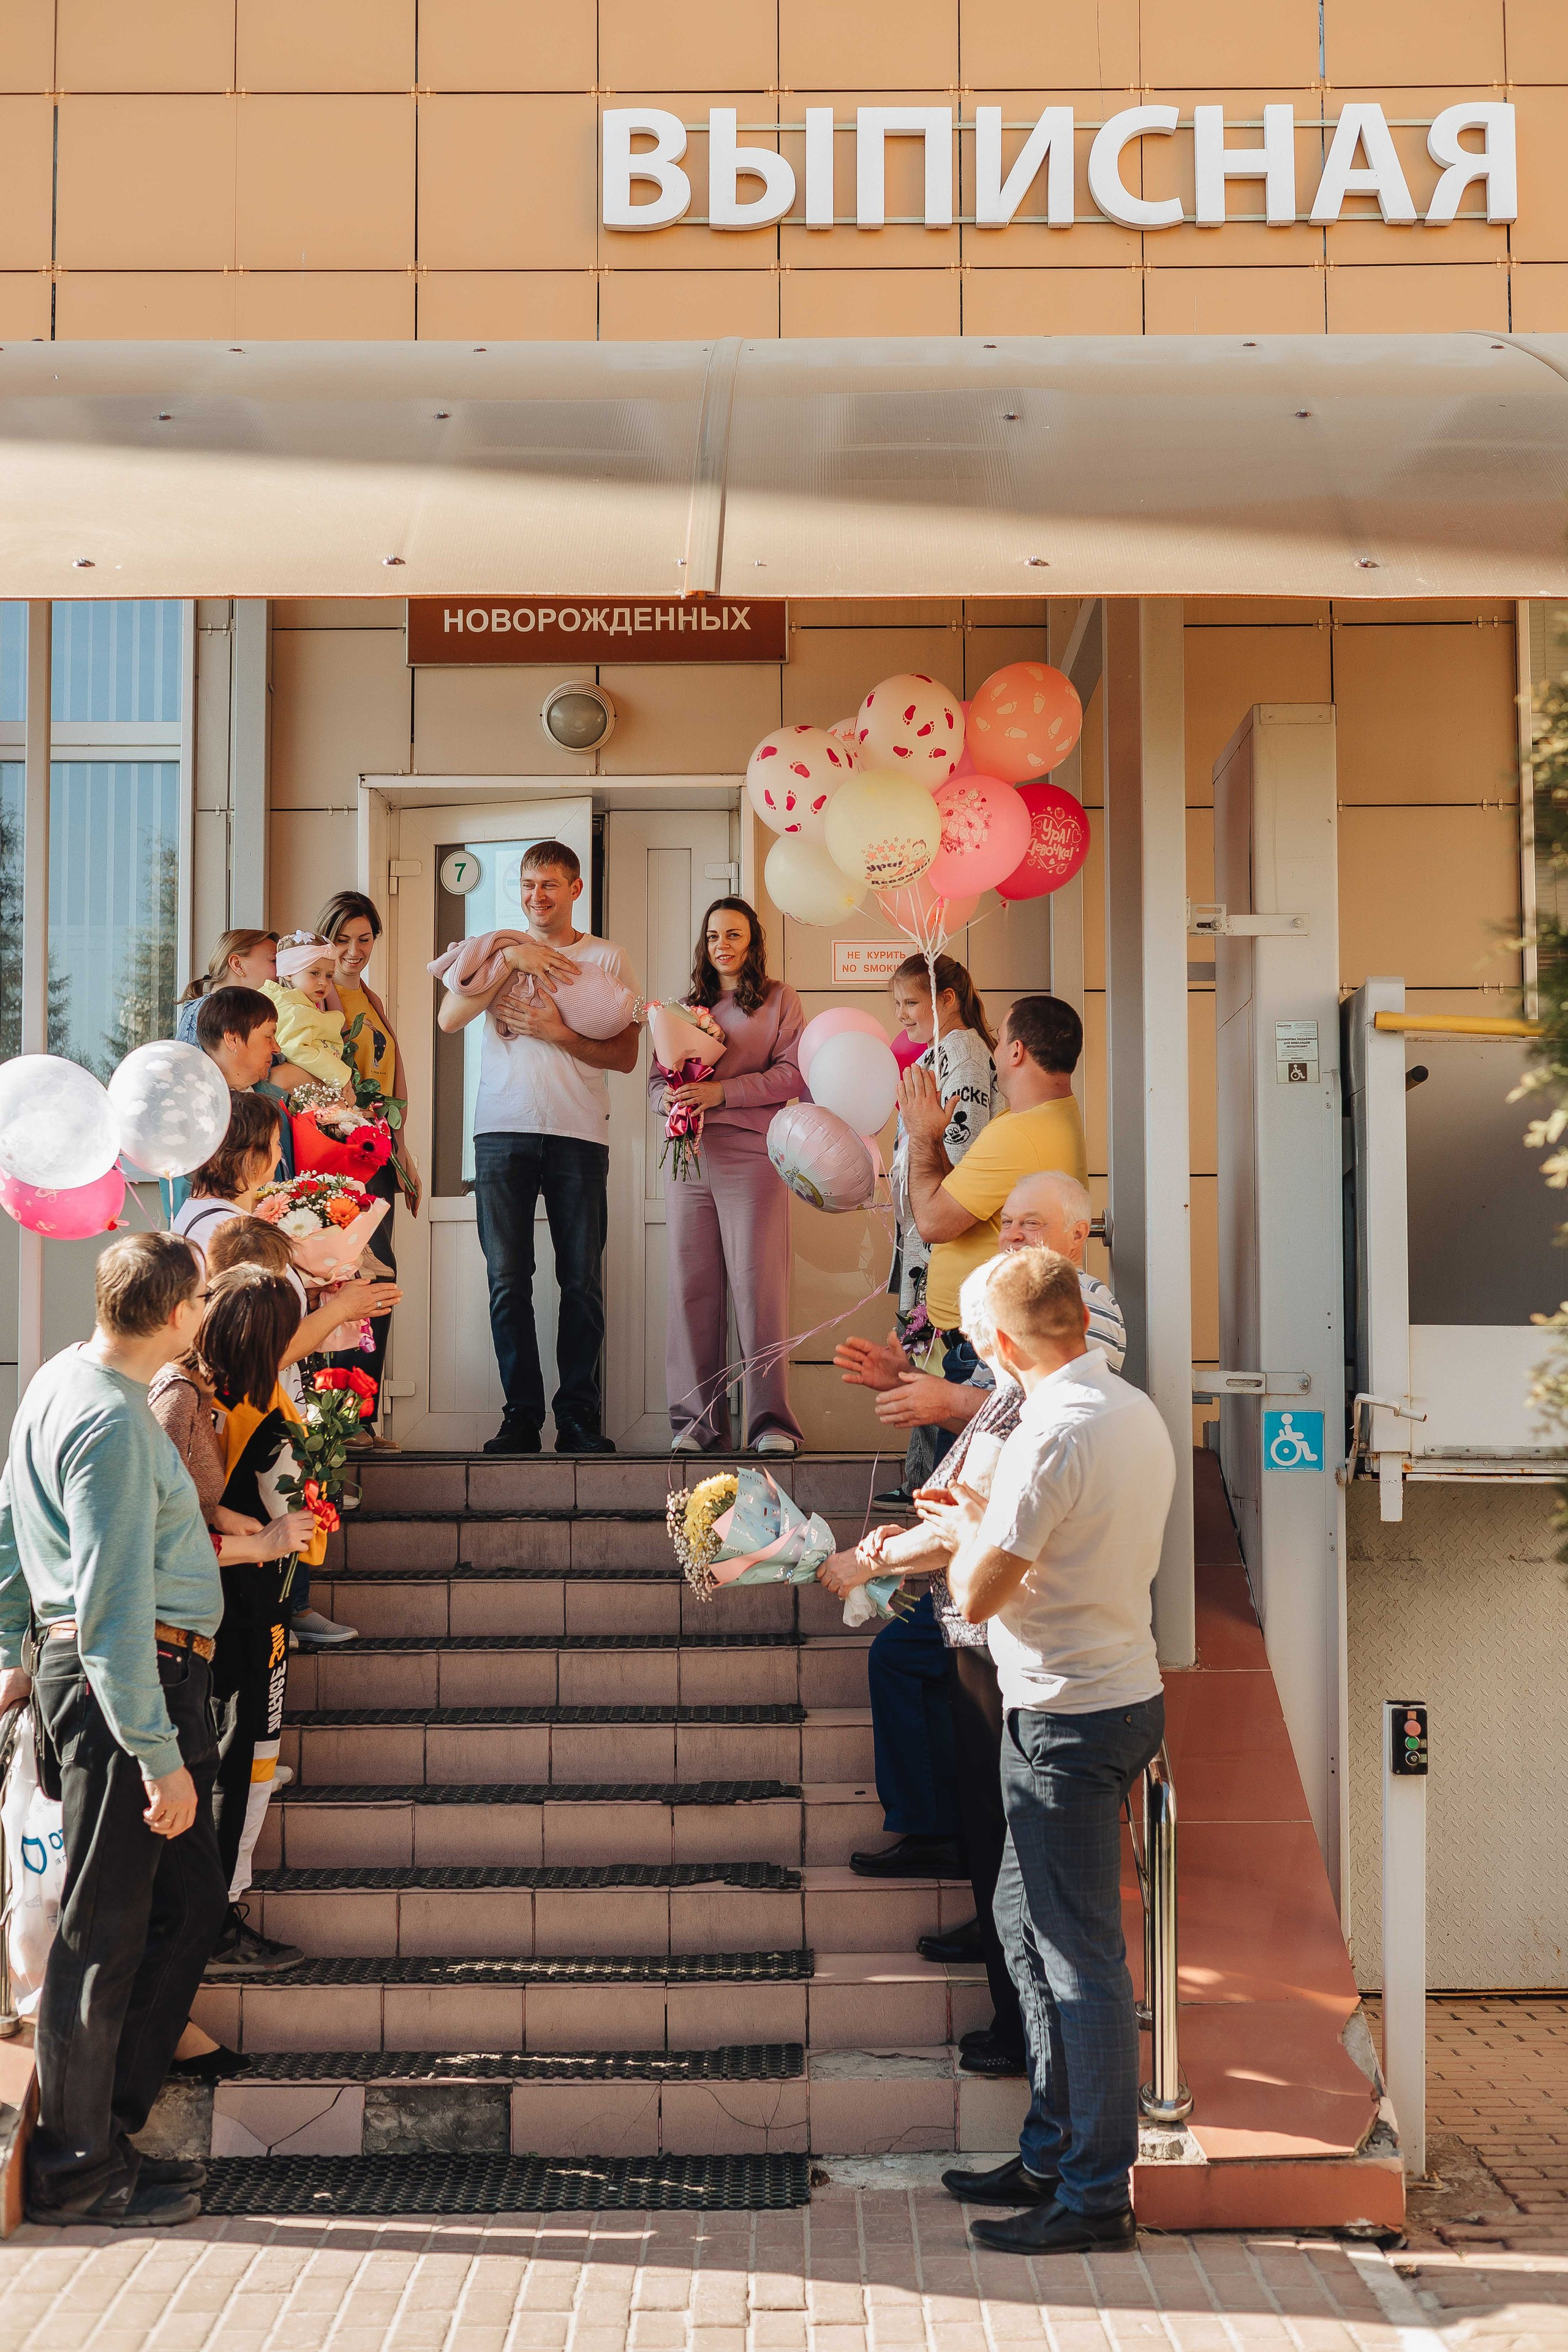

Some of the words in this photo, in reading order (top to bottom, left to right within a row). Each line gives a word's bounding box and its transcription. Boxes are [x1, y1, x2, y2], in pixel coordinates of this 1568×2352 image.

[603, 102, 1518, 231] ВЫПИСНАЯ
[443, 606, 752, 636] НОВОРОЖДЕННЫХ
[454, 862, 467, 882] 7
[842, 964, 857, 973] NO
[863, 964, 901, 973] SMOKI
